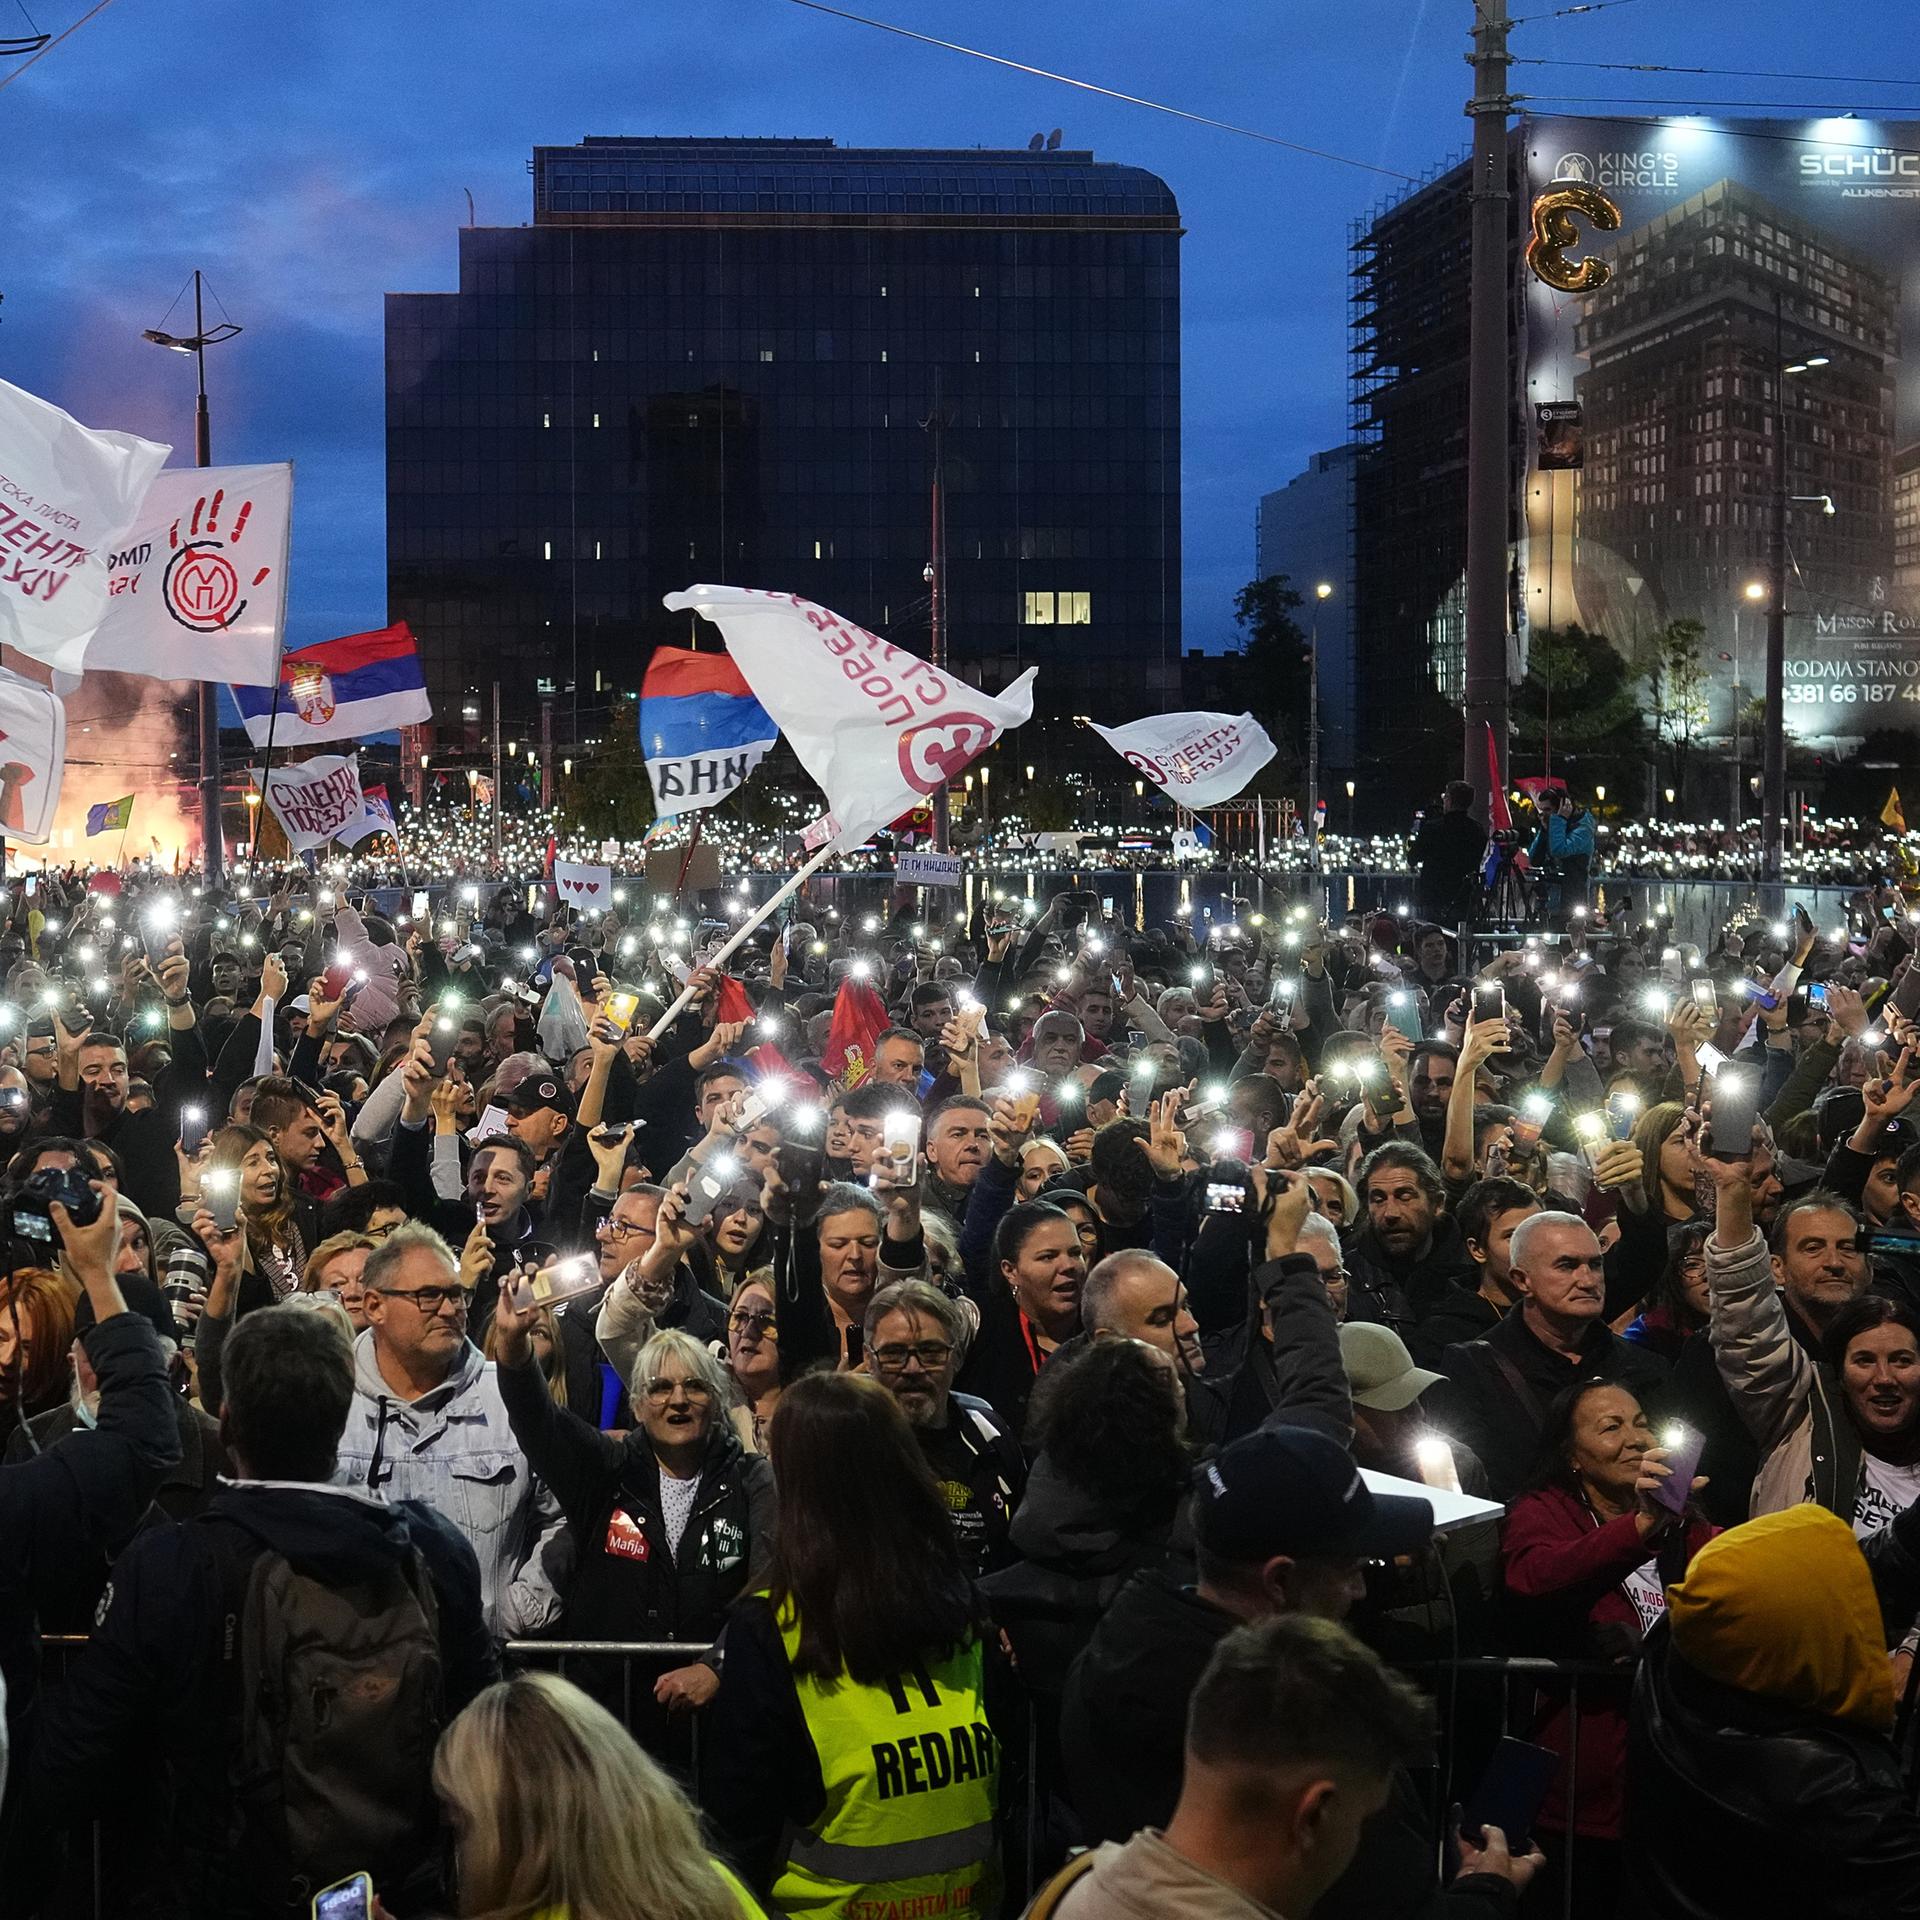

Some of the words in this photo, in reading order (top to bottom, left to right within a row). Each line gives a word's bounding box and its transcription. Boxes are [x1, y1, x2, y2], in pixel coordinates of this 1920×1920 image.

[1599, 152, 1679, 171] KING'S
[1599, 171, 1679, 187] CIRCLE
[33, 503, 81, 532] ЛИСТА
[1817, 612, 1875, 633] MAISON
[1883, 611, 1920, 633] ROY
[1784, 660, 1853, 680] RODAJA
[1857, 660, 1920, 678] STANO
[1830, 684, 1857, 703] 66
[1862, 684, 1896, 702] 187
[609, 1535, 646, 1555] Mafija
[718, 1540, 731, 1554] ili
[871, 1721, 996, 1801] REDAR
